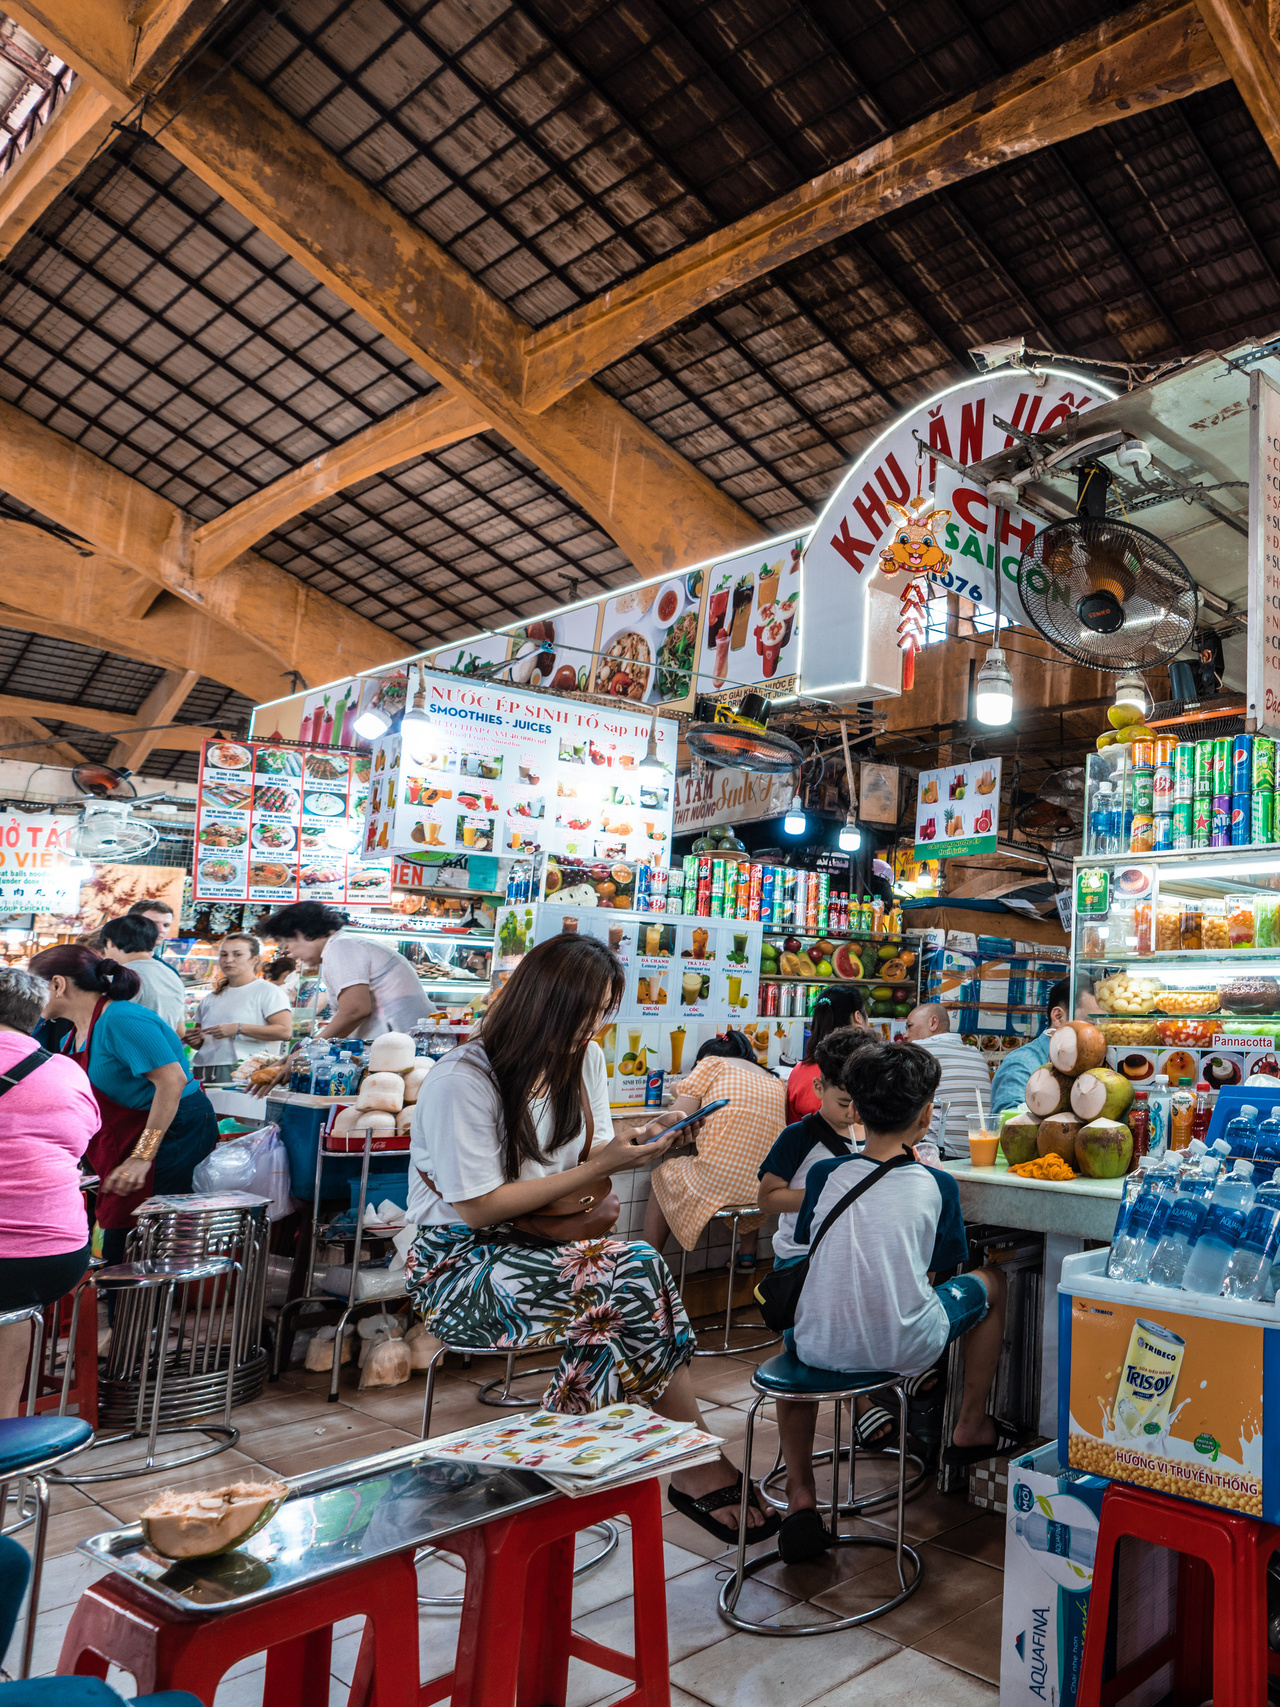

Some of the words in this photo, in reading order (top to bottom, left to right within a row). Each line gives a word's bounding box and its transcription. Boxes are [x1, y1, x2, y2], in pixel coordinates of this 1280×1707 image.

[830, 452, 911, 574] KHU
[945, 522, 995, 570] SÀI
[429, 703, 503, 726] SMOOTHIES
[512, 719, 552, 735] JUICES
[430, 685, 491, 710] NƯỚC
[495, 693, 520, 713] ÉP
[524, 705, 569, 725] SINH
[574, 712, 600, 730] TỐ
[633, 727, 665, 743] 102
[1213, 1035, 1273, 1049] Pannacotta
[1144, 1341, 1176, 1362] TRIBECO
[1116, 1451, 1156, 1473] HƯƠNG
[1157, 1460, 1168, 1477] VỊ
[1169, 1464, 1214, 1486] TRUYỀN
[1215, 1473, 1259, 1497] THỐNG
[1029, 1606, 1051, 1701] AQUAFINA
